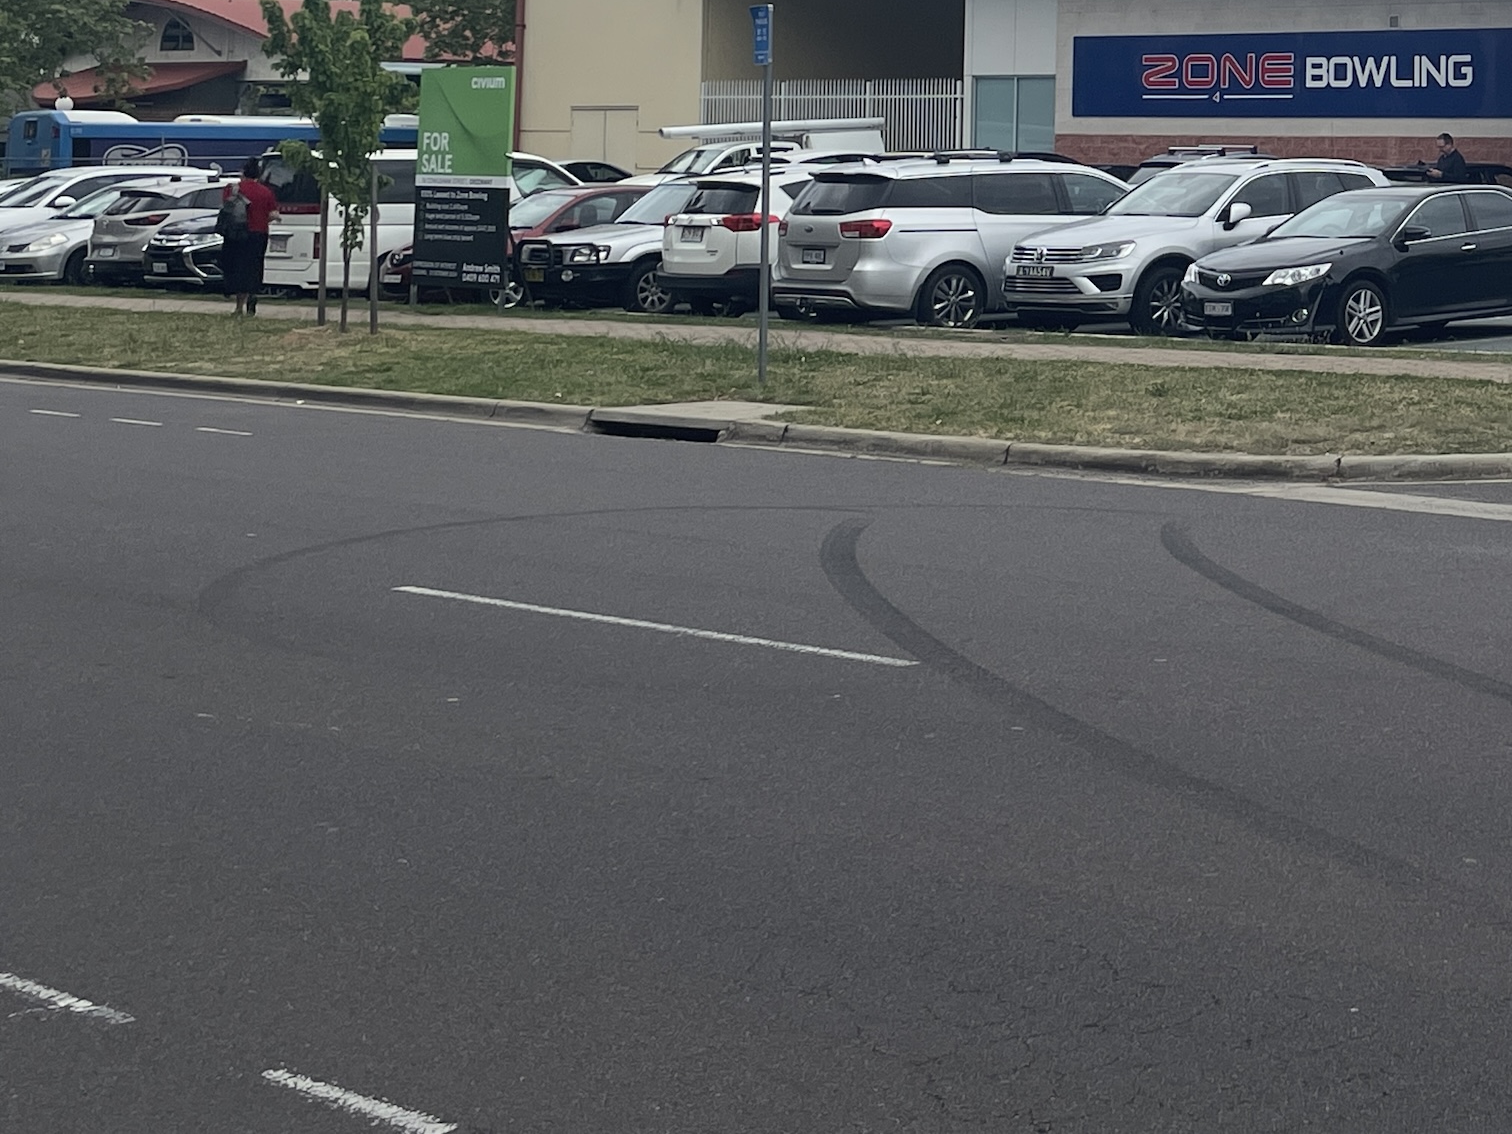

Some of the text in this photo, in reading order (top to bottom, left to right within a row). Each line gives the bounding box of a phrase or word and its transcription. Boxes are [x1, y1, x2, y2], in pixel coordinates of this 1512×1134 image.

[1142, 53, 1473, 89] ZONE BOWLING
[471, 77, 506, 89] civium
[422, 132, 449, 151] FOR
[421, 154, 453, 173] SALE
